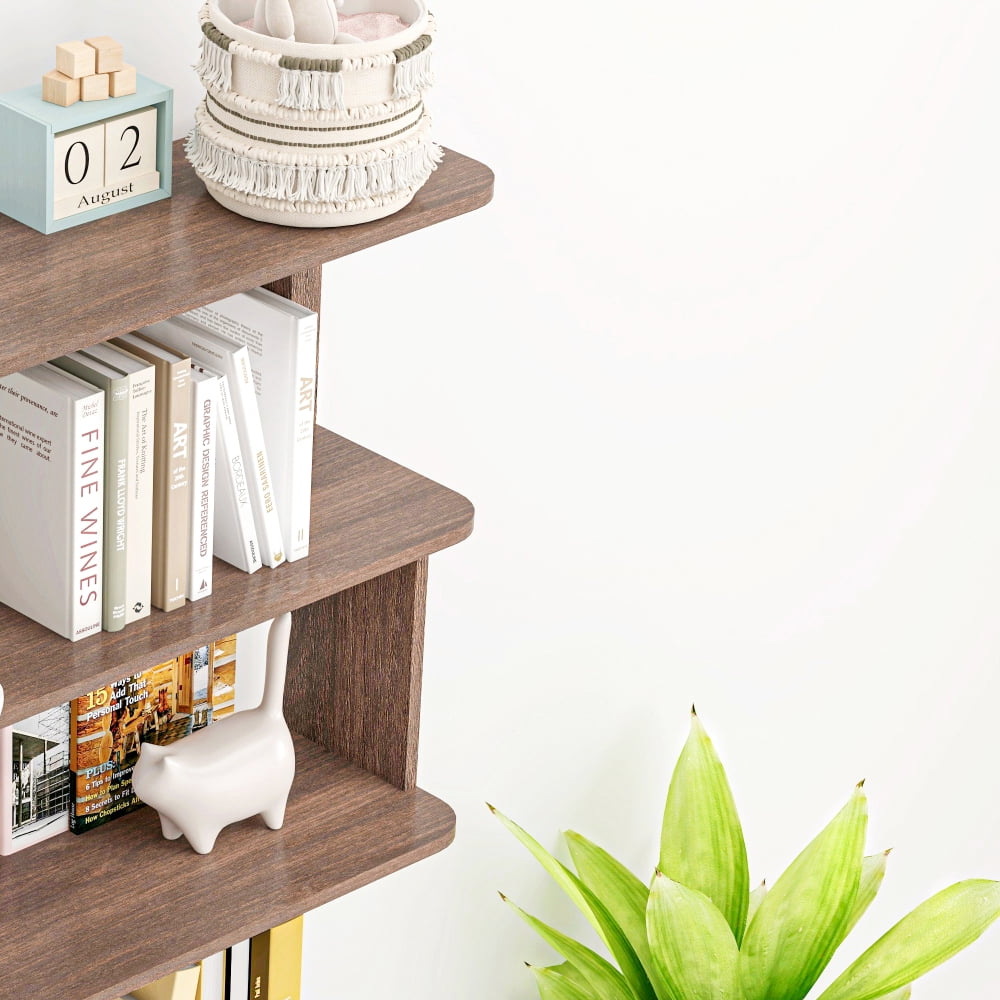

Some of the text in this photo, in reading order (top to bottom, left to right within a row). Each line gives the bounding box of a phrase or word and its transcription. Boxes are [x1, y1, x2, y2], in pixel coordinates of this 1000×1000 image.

[64, 125, 142, 185] 0 2
[77, 182, 134, 208] August
[7, 388, 20, 398] their
[50, 410, 59, 418] are
[299, 376, 313, 412] ART
[202, 399, 211, 446] GRAPHIC
[36, 435, 52, 446] expert
[172, 422, 188, 459] ART
[201, 448, 210, 488] DESIGN
[232, 455, 248, 506] BORDEAUX
[256, 451, 274, 513] EERO SAARINEN
[80, 429, 99, 606] FINE WINES
[116, 458, 126, 551] FRANK LLOYD WRIGHT
[200, 489, 209, 558] REFERENCED
[86, 686, 108, 710] 15
[110, 678, 147, 700] Add That
[87, 690, 149, 722] Personal Touch
[85, 760, 116, 779] PLUS:
[85, 783, 90, 791] 6
[92, 779, 104, 788] Tips
[85, 793, 98, 802] How
[107, 783, 120, 793] Plan
[85, 805, 90, 813] 8
[91, 797, 113, 810] Secrets
[114, 793, 121, 801] to
[121, 789, 130, 798] Fit
[85, 814, 99, 825] How
[99, 800, 130, 818] Chopsticks
